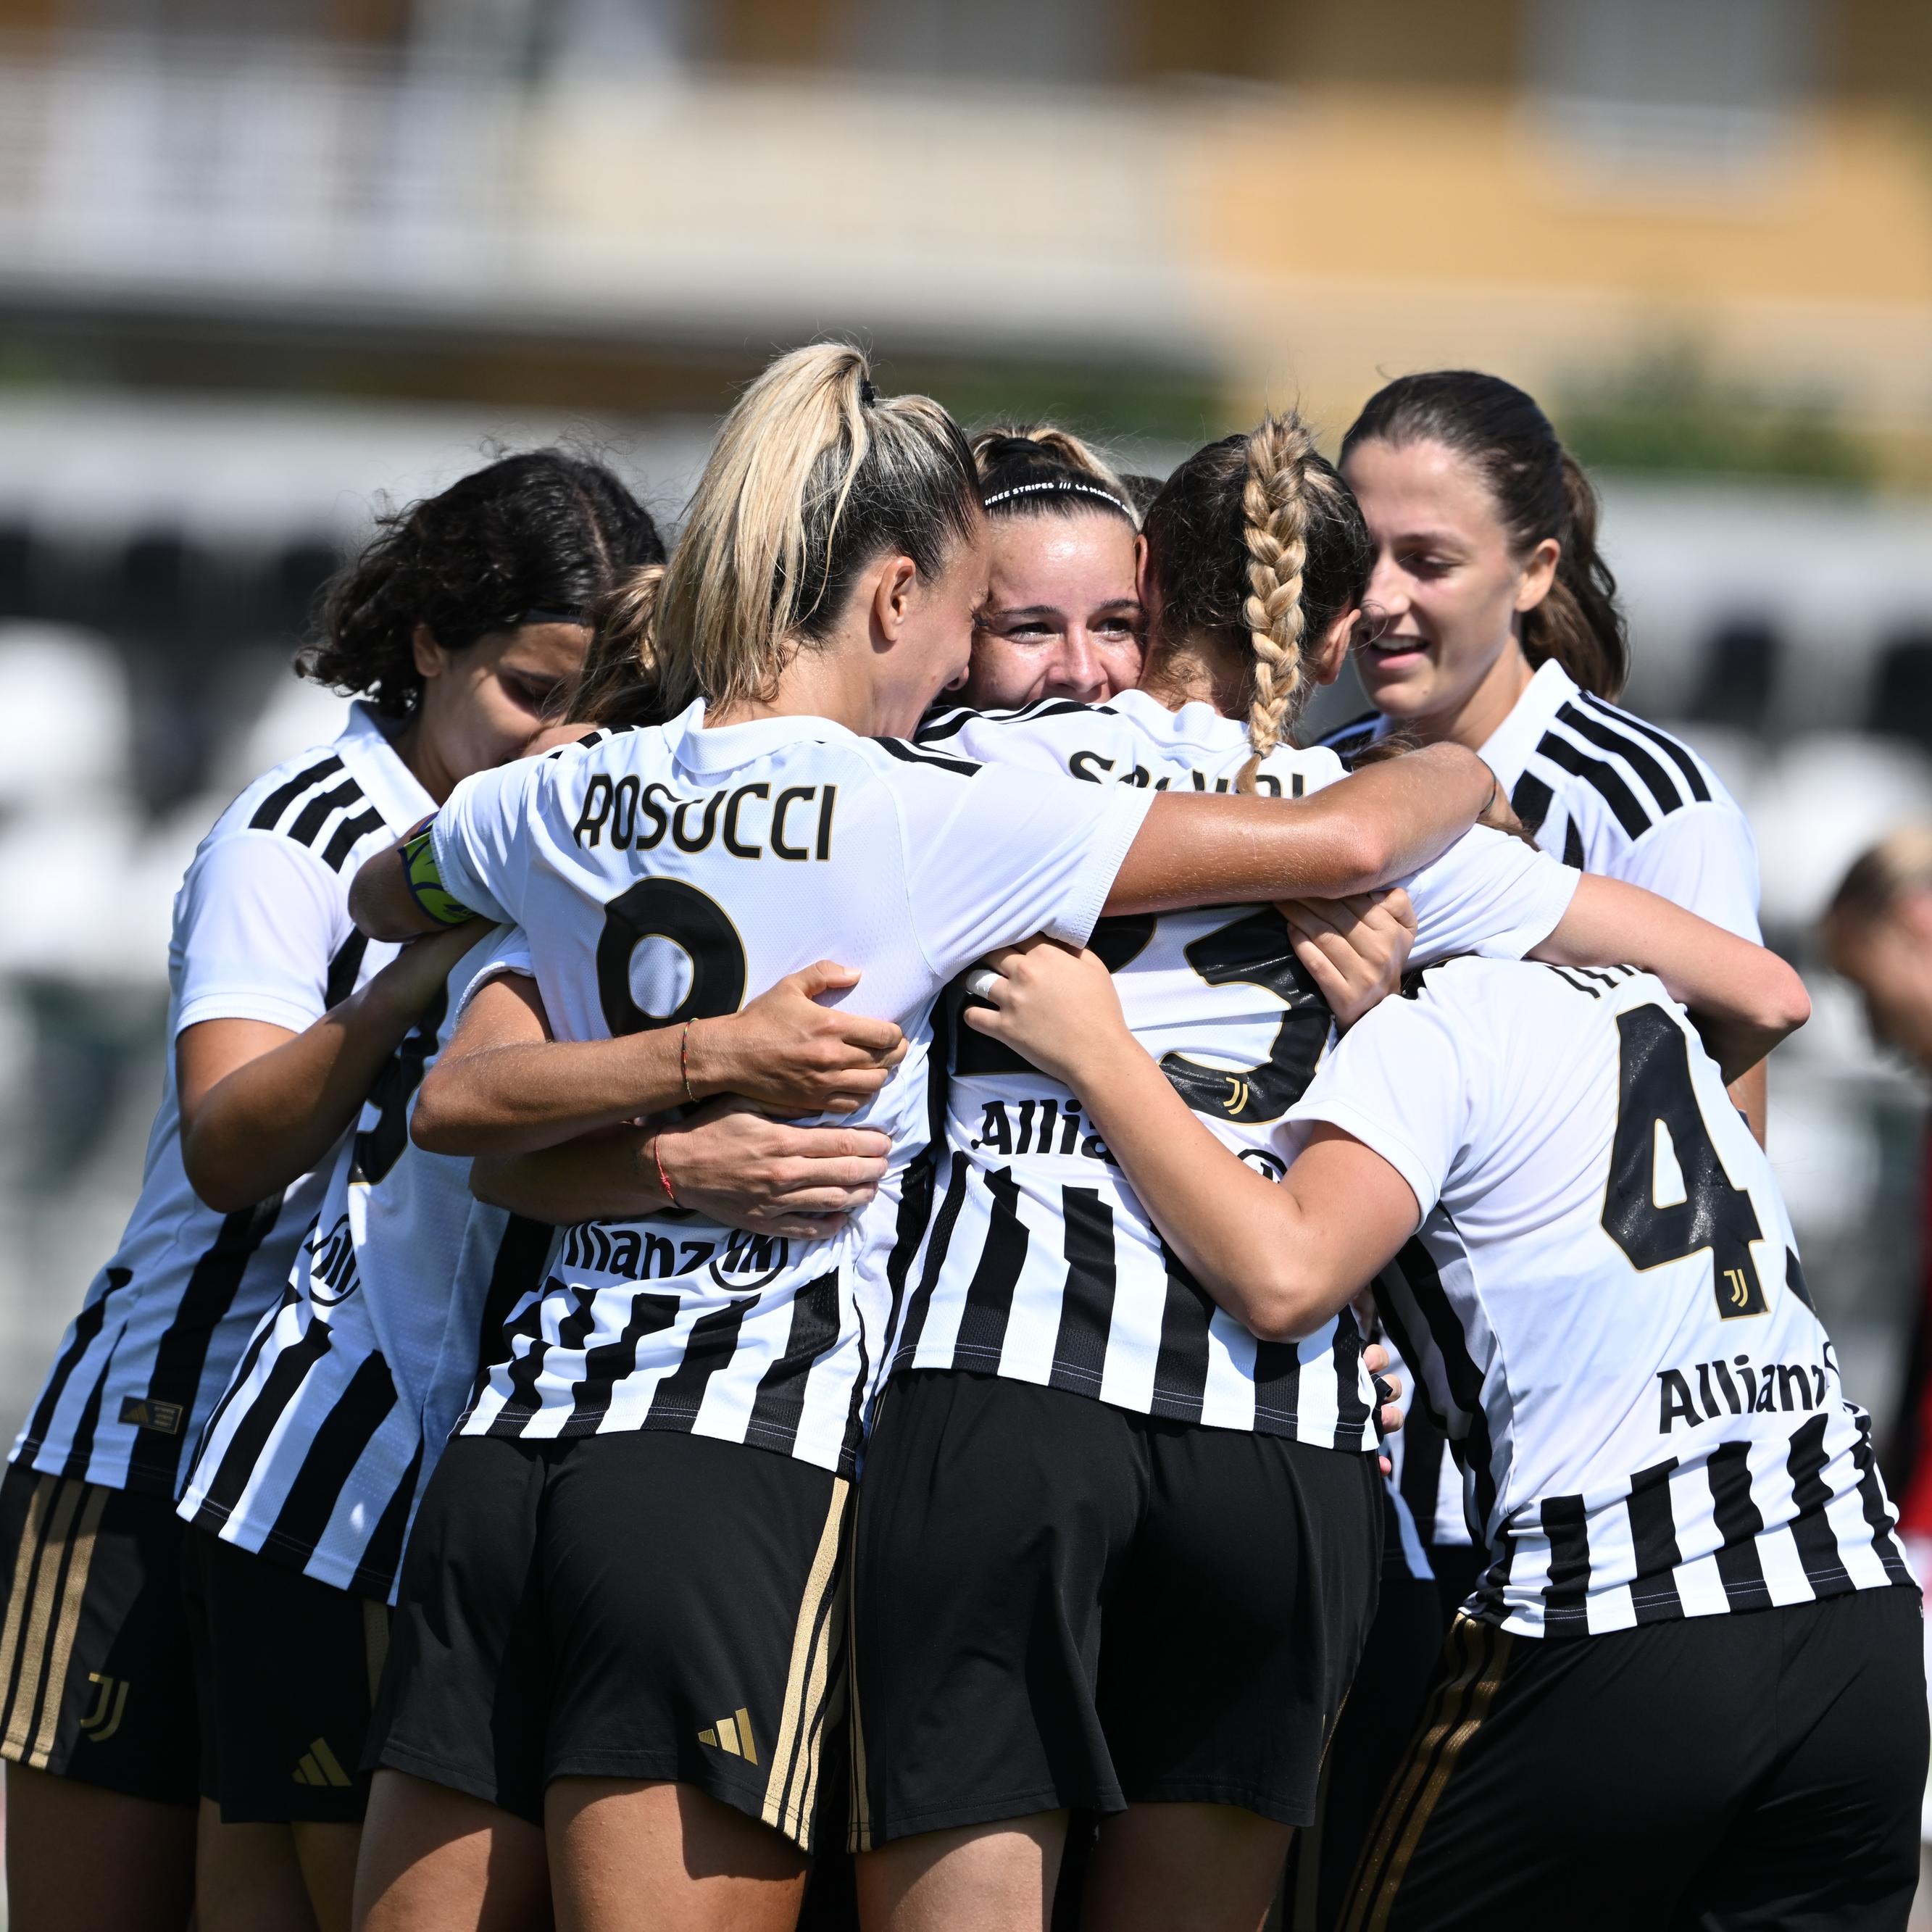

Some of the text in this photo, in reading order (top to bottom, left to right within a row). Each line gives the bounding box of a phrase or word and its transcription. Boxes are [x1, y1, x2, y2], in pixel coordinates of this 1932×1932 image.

[985, 491, 1010, 505] HREE
[1012, 482, 1054, 494] STRIPES
[572, 773, 838, 862] ROSUCCI
[971, 1099, 1121, 1167] Allia
[1599, 1002, 1771, 1321] 4
[562, 1220, 716, 1281] llianz
